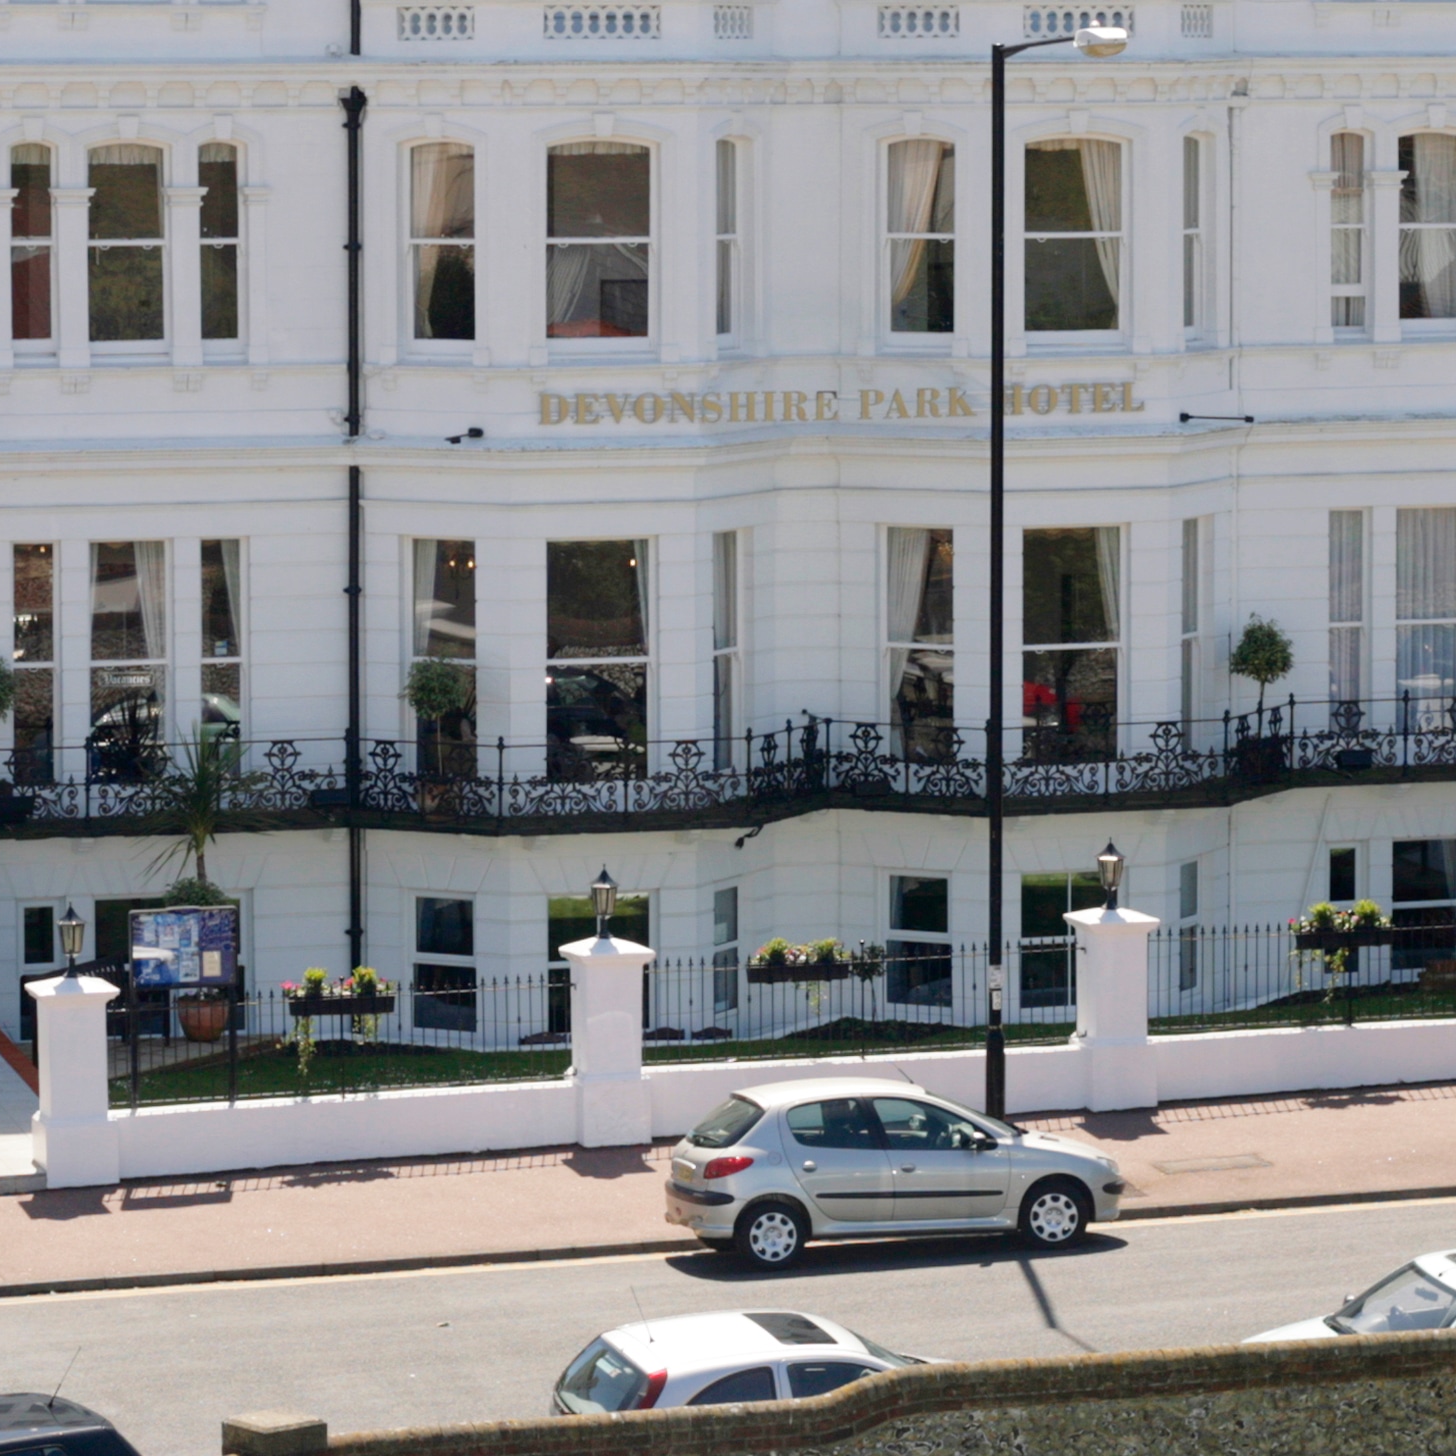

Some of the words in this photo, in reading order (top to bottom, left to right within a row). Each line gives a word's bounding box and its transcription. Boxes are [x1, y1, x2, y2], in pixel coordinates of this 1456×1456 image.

[538, 390, 838, 426] DEVONSHIRE
[857, 386, 976, 420] PARK
[1003, 381, 1145, 416] HOTEL
